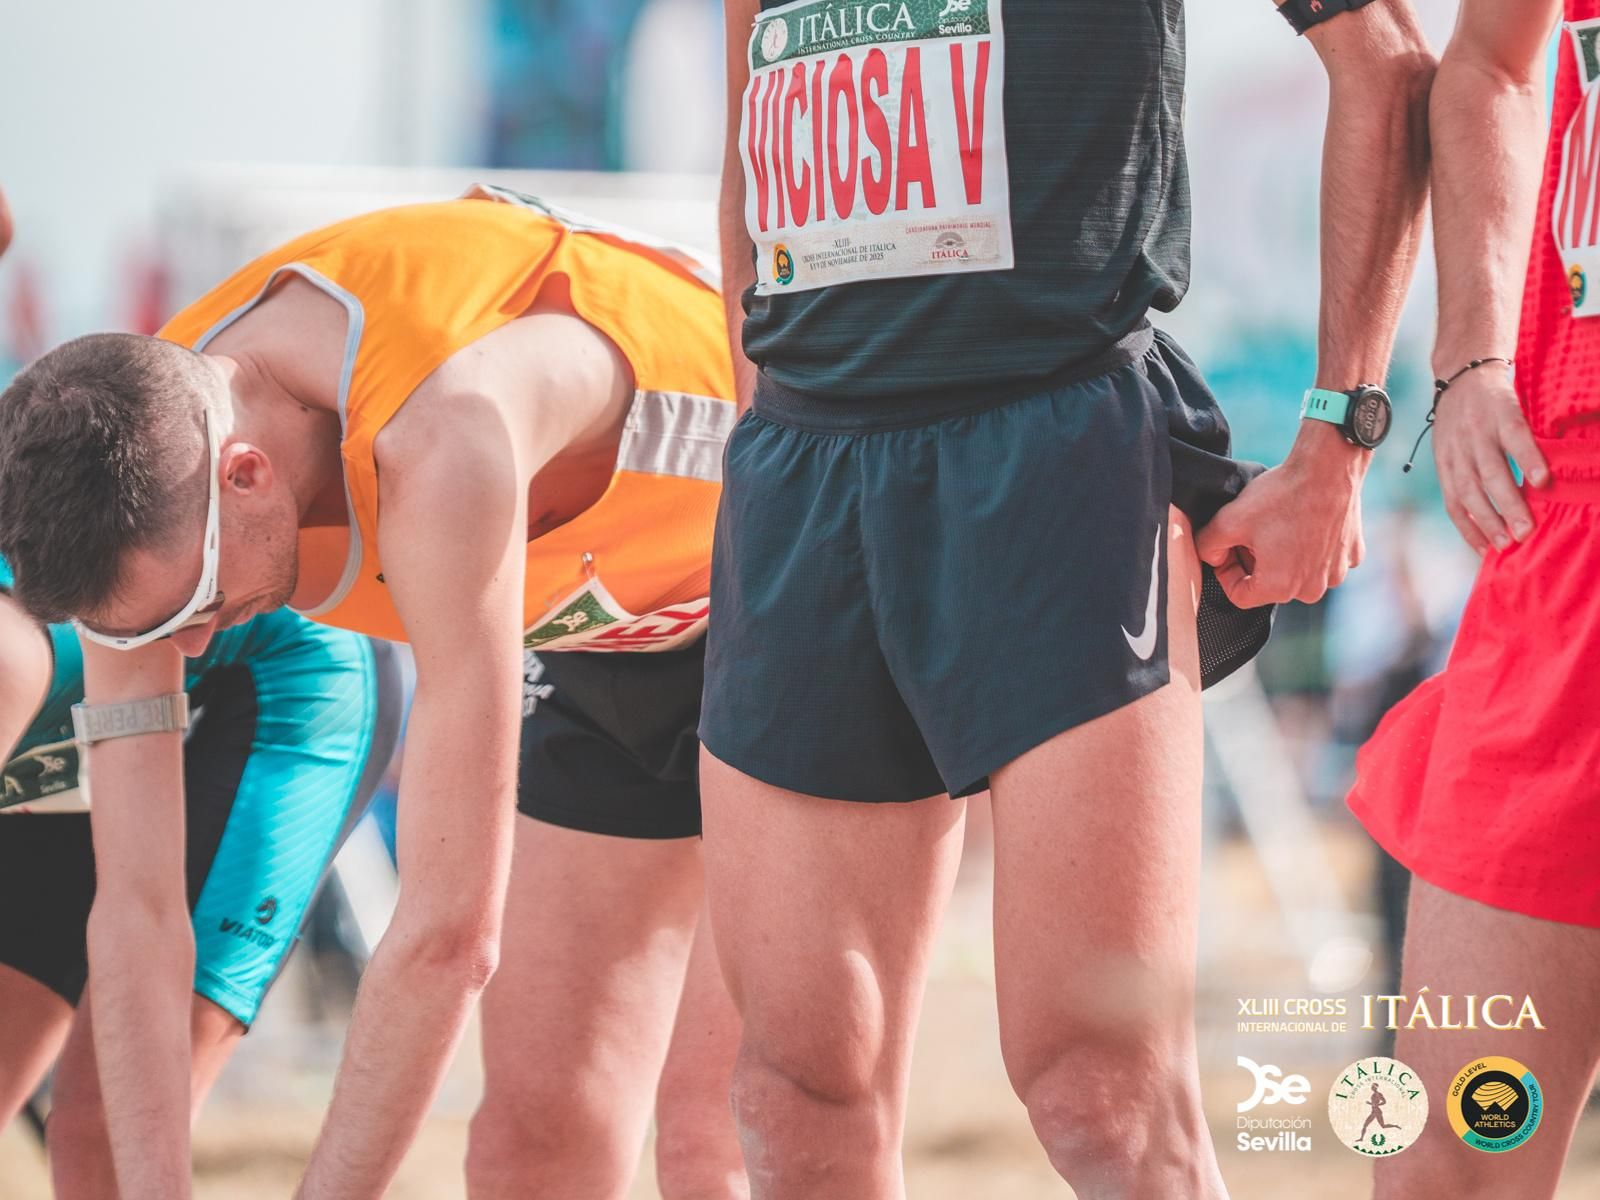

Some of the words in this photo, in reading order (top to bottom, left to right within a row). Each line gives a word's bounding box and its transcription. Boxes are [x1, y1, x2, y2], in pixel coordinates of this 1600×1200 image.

[798, 1, 916, 46] ITÁLICA
[938, 23, 972, 35] Sevilla
[797, 38, 849, 55] INTERNATIONAL
[851, 34, 873, 45] CROSS
[875, 30, 917, 41] COUNTRY
[747, 47, 937, 232] VICIOSA
[949, 41, 991, 205] V
